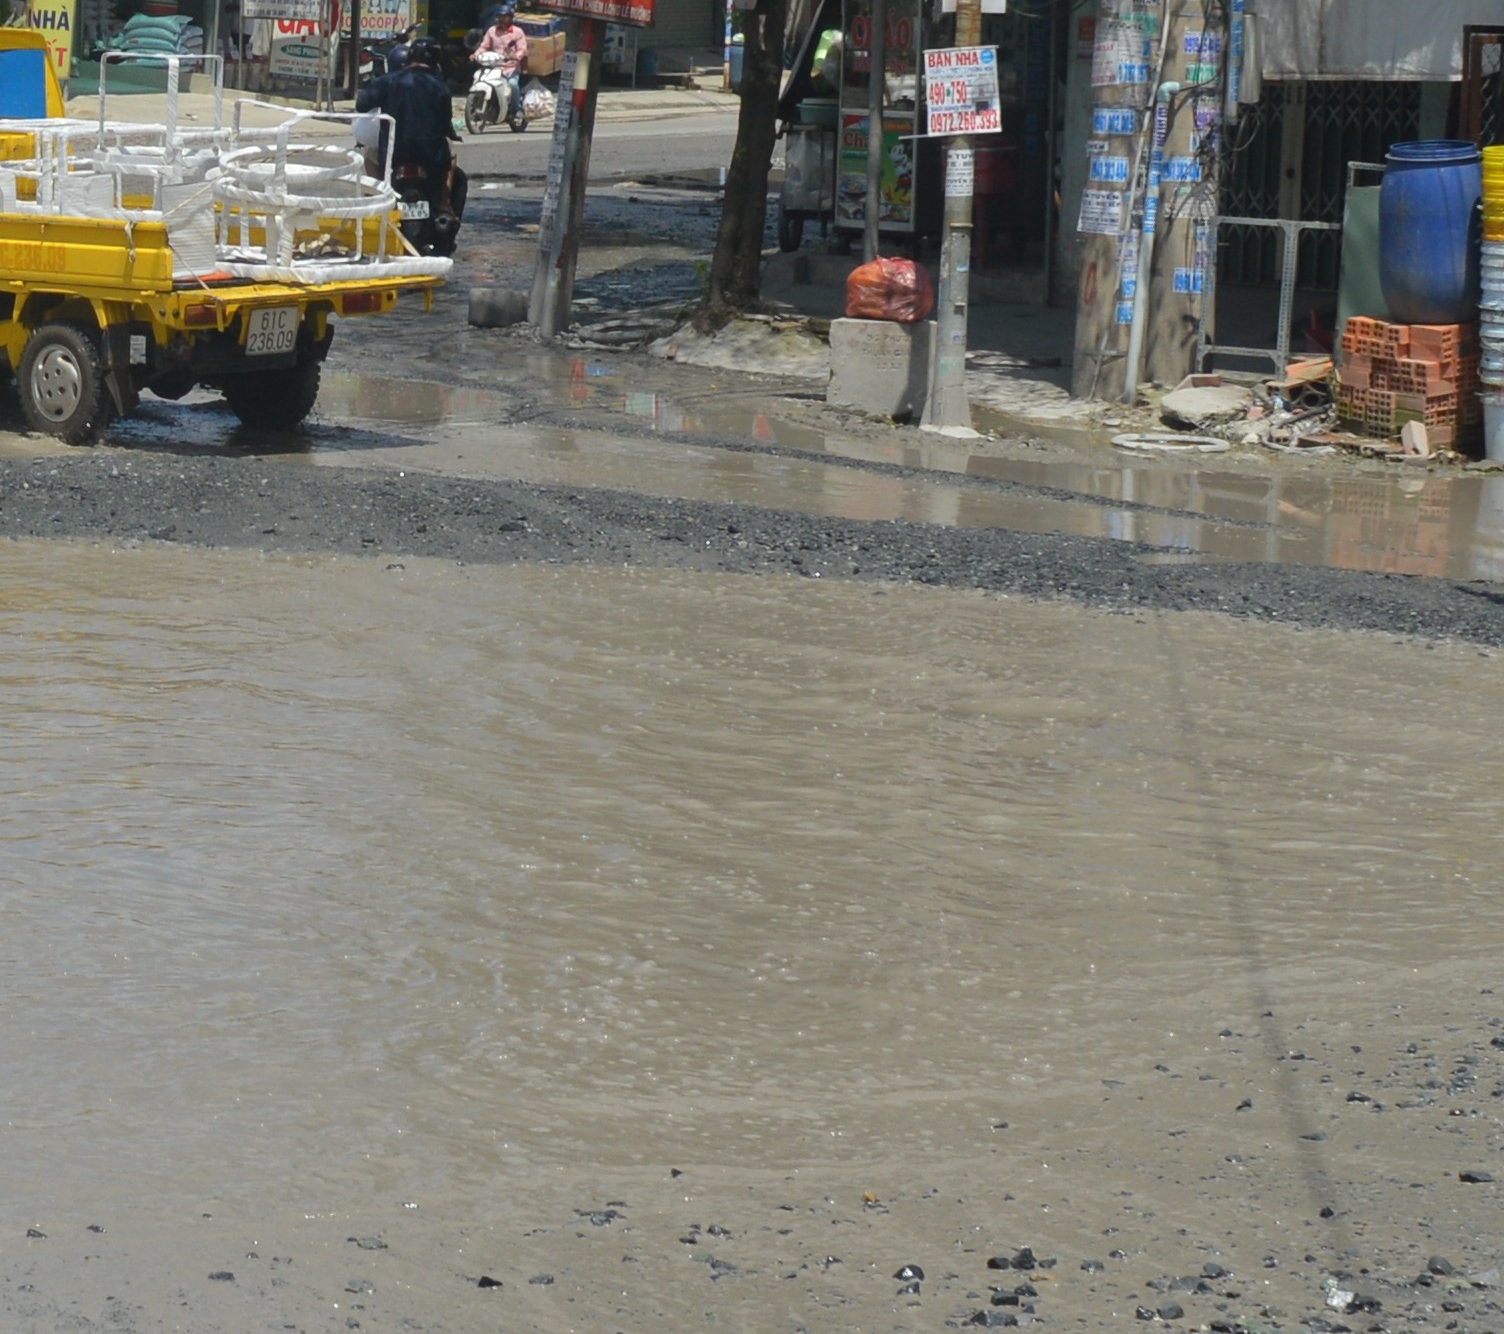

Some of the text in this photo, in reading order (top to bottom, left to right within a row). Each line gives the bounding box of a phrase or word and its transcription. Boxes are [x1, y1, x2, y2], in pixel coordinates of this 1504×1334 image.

[29, 5, 70, 31] NHÀ
[261, 310, 287, 331] 61C
[248, 330, 293, 352] 236.09
